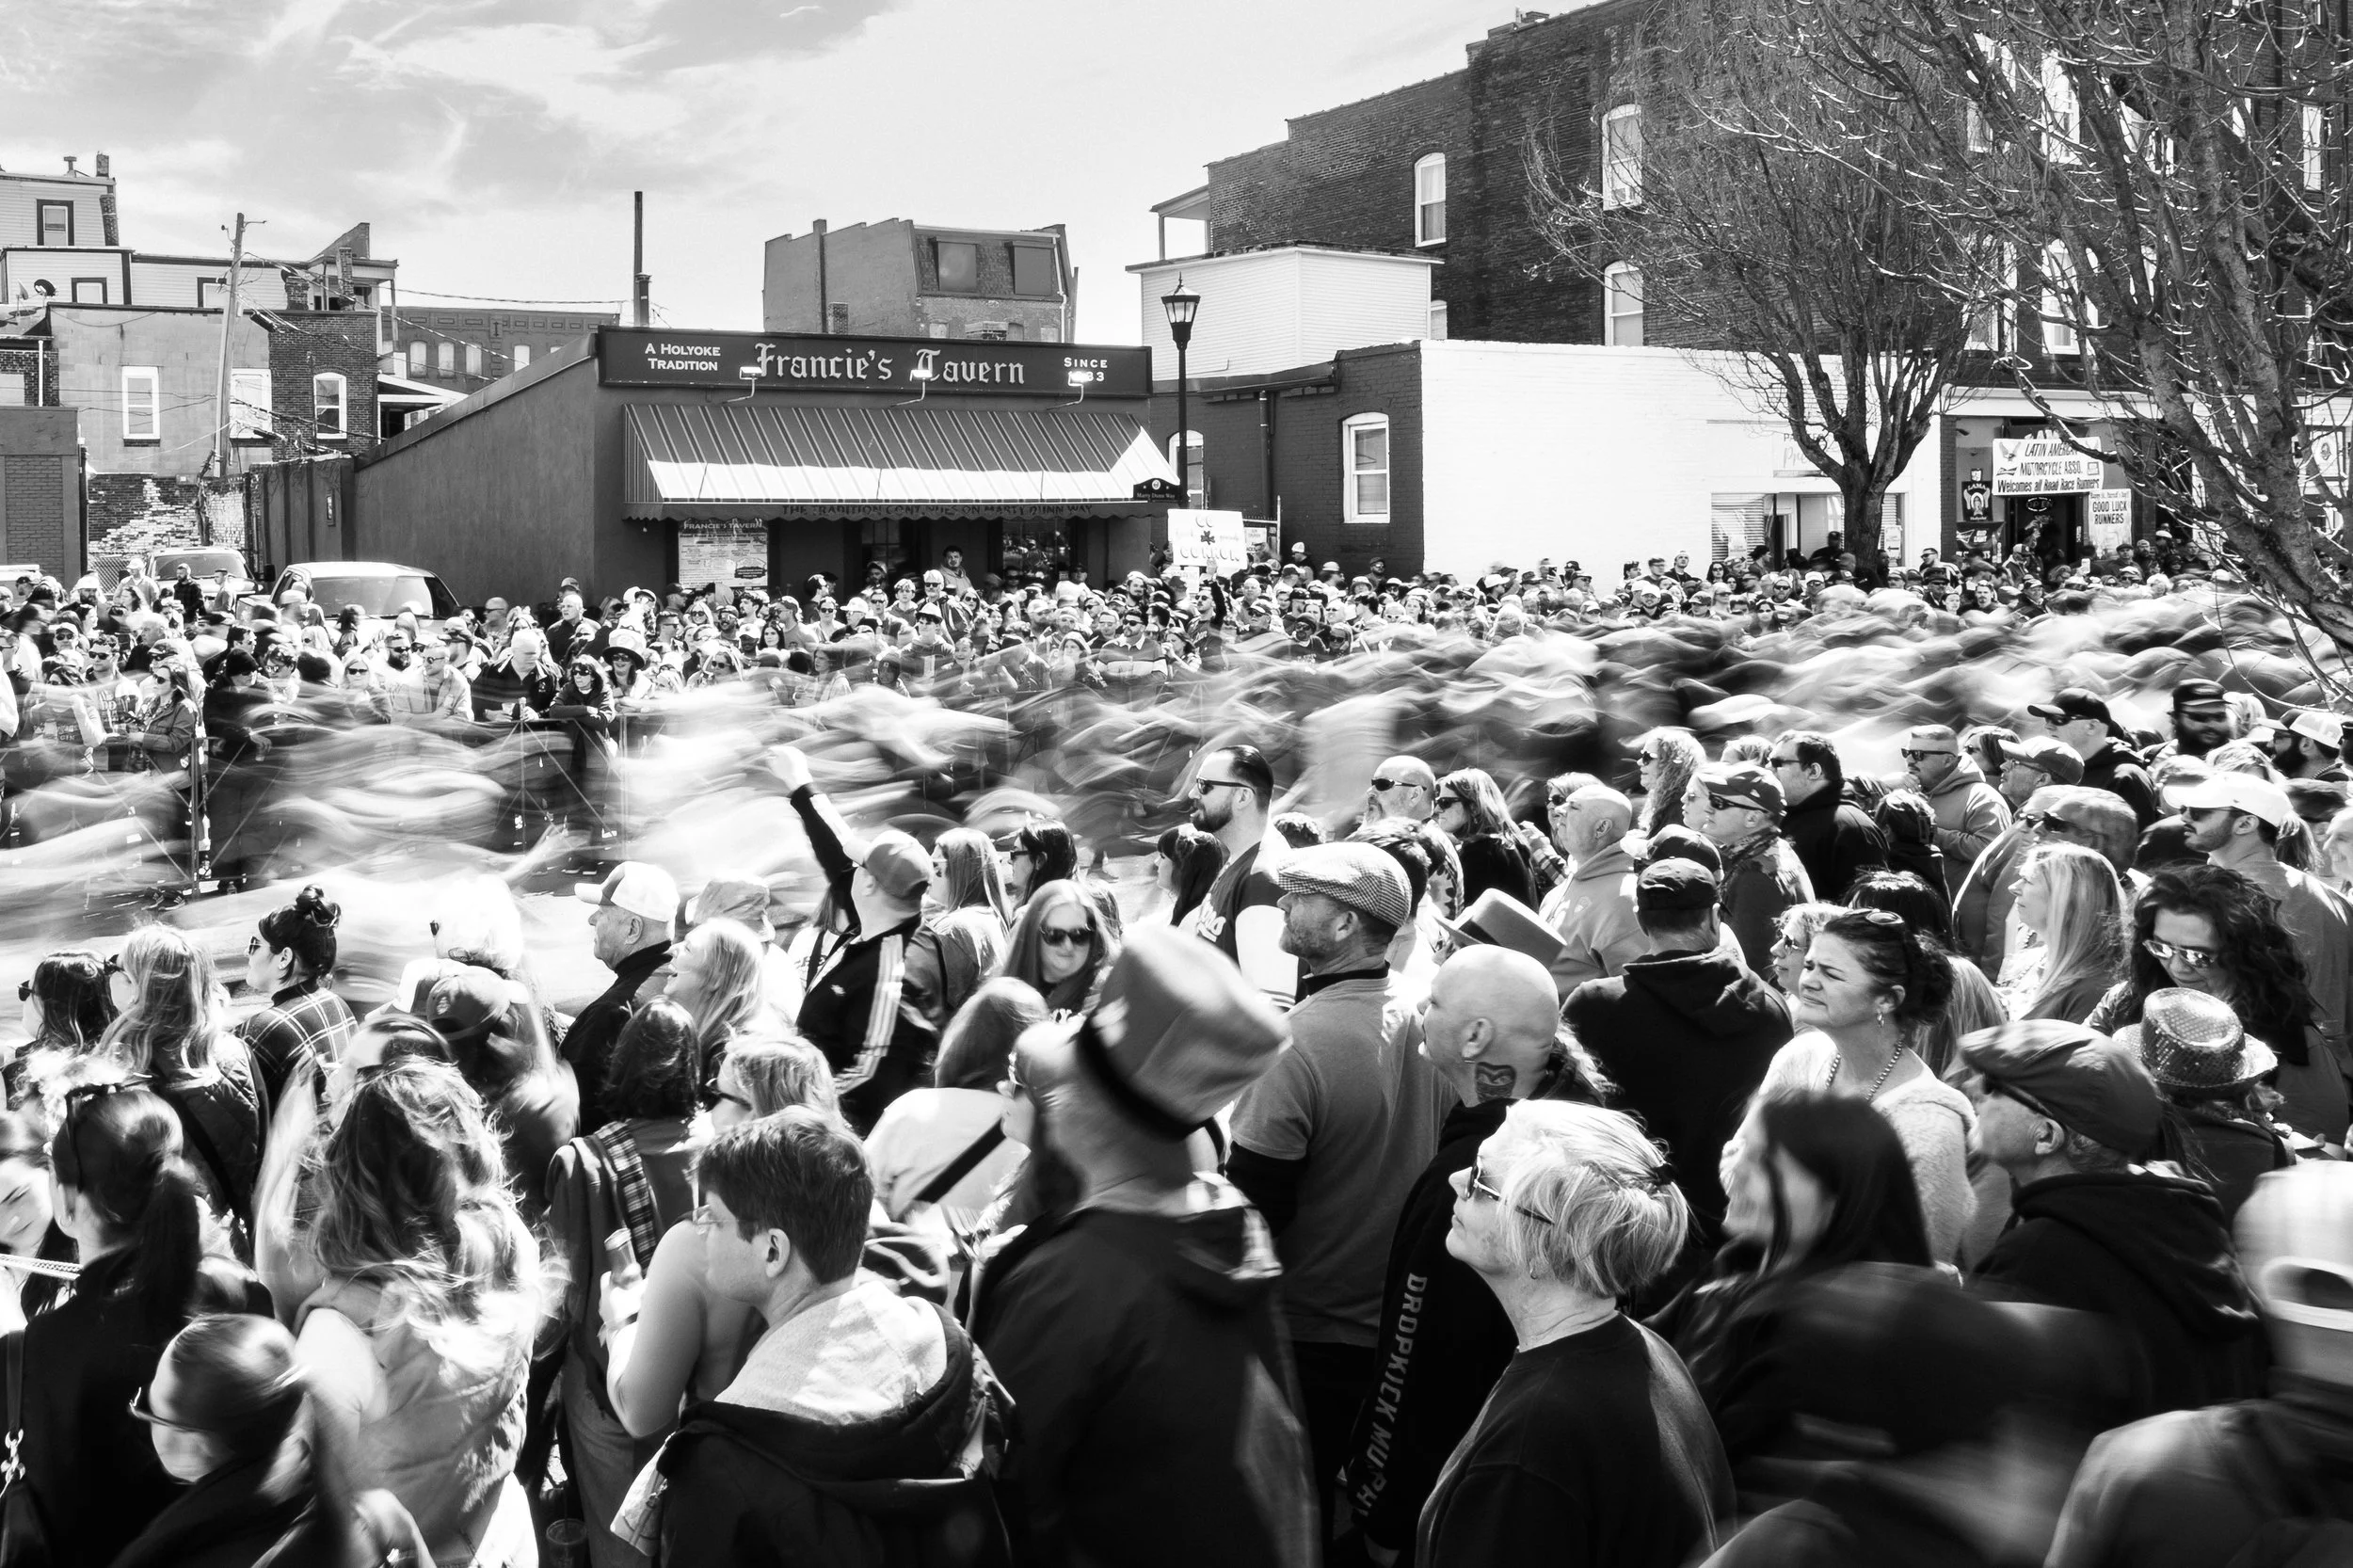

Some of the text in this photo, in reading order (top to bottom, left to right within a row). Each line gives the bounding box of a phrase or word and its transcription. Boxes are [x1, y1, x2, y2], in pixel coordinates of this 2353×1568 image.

[645, 343, 721, 357] A HOLYOKE
[648, 358, 718, 371] TRADITION
[754, 343, 1025, 384] Francie's Tavern
[1064, 357, 1108, 368] SINCE
[1068, 371, 1105, 382] 83
[2025, 441, 2078, 457] LATIN AMERICA
[2019, 461, 2062, 476] MOTORCYCLE
[1997, 479, 2033, 493] Welcomes
[2034, 479, 2043, 491] all
[2060, 478, 2074, 490] Race
[886, 504, 958, 516] CONTNUES
[962, 504, 981, 515] ON
[1067, 504, 1093, 515] WAY
[2092, 501, 2128, 513] GOOD LUCK
[2094, 513, 2124, 524] RUNNERS
[1355, 1272, 1428, 1518] DROPKICK MUPH
